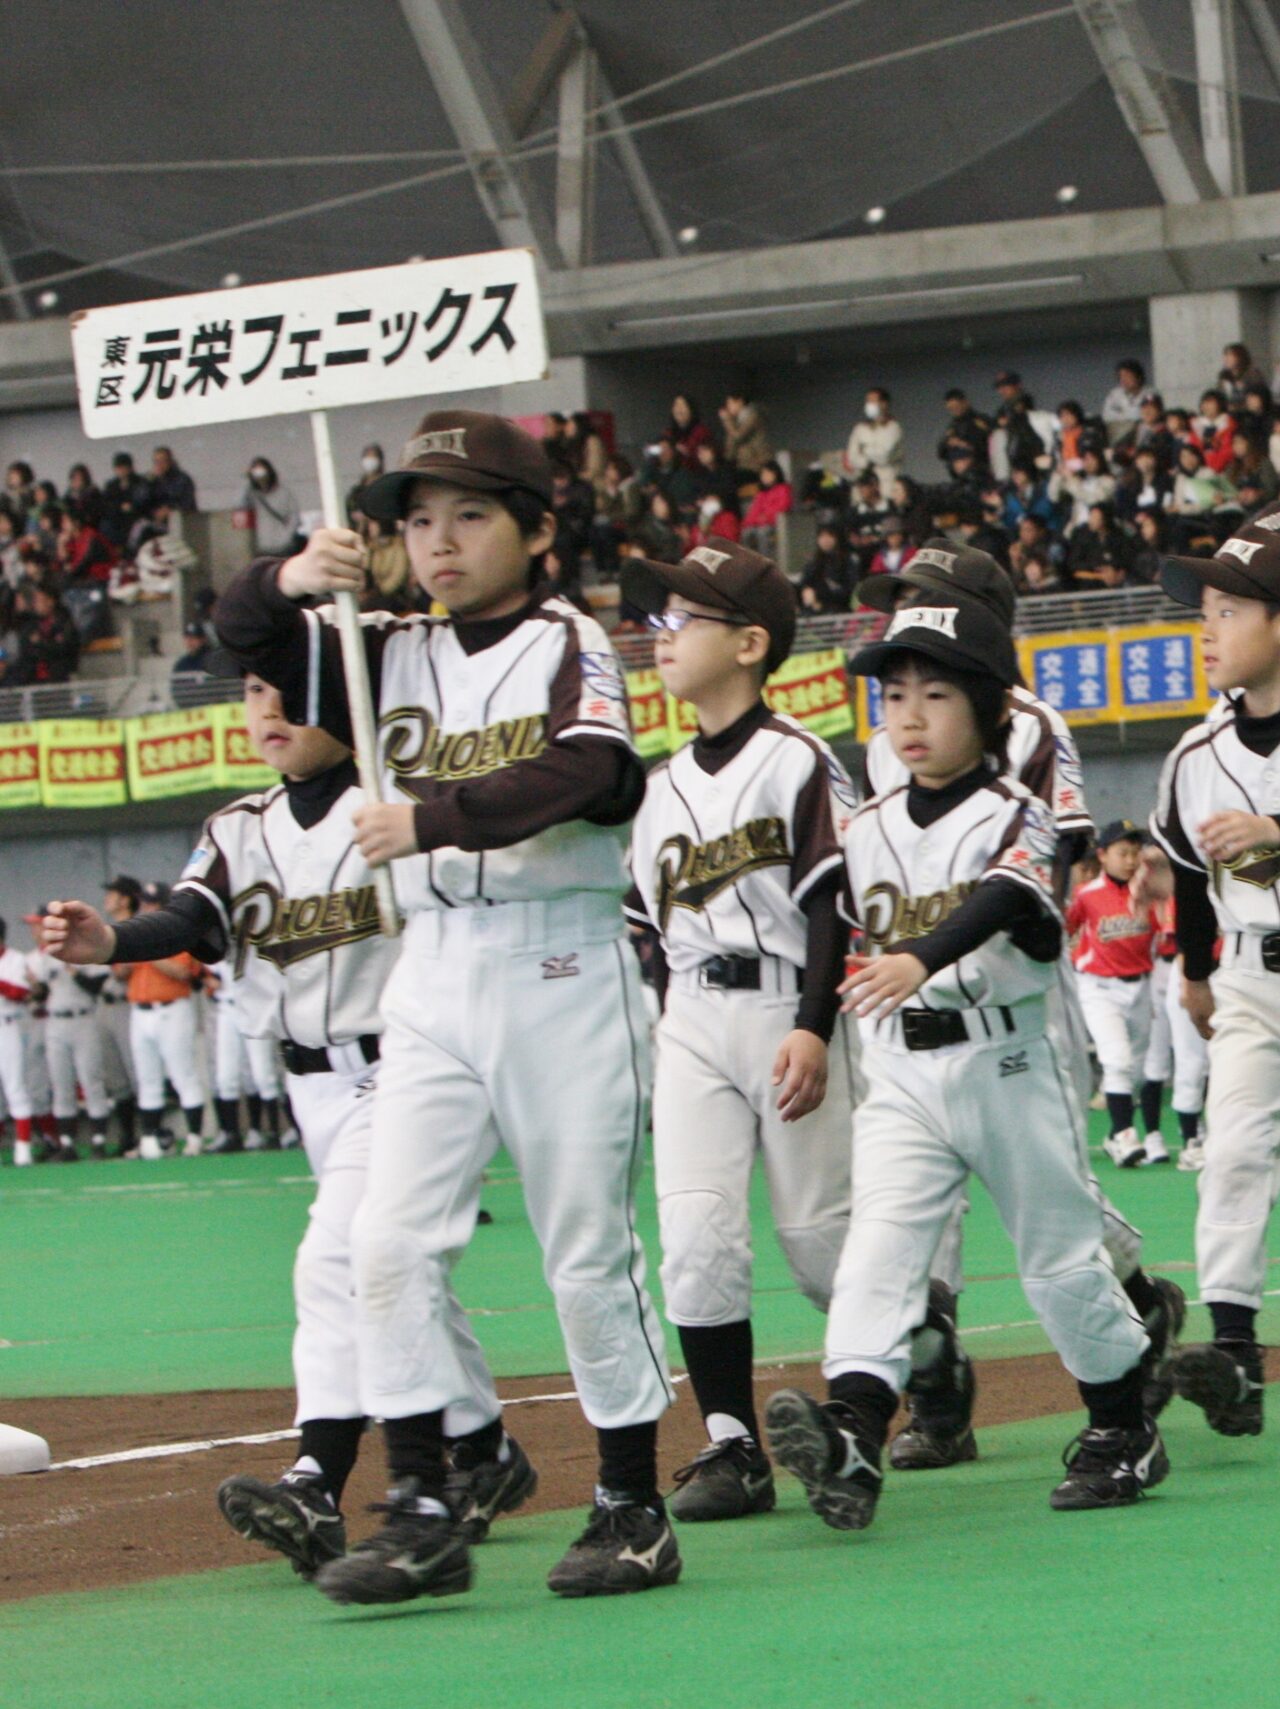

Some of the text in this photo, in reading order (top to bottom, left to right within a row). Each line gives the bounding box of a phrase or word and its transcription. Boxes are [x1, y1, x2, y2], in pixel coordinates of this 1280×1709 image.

[132, 282, 519, 403] 元栄フェニックス
[95, 335, 131, 408] 東区
[1041, 649, 1100, 679] 交通
[1128, 640, 1185, 671] 交通
[1043, 678, 1101, 707] 安全
[1129, 670, 1186, 700] 安全
